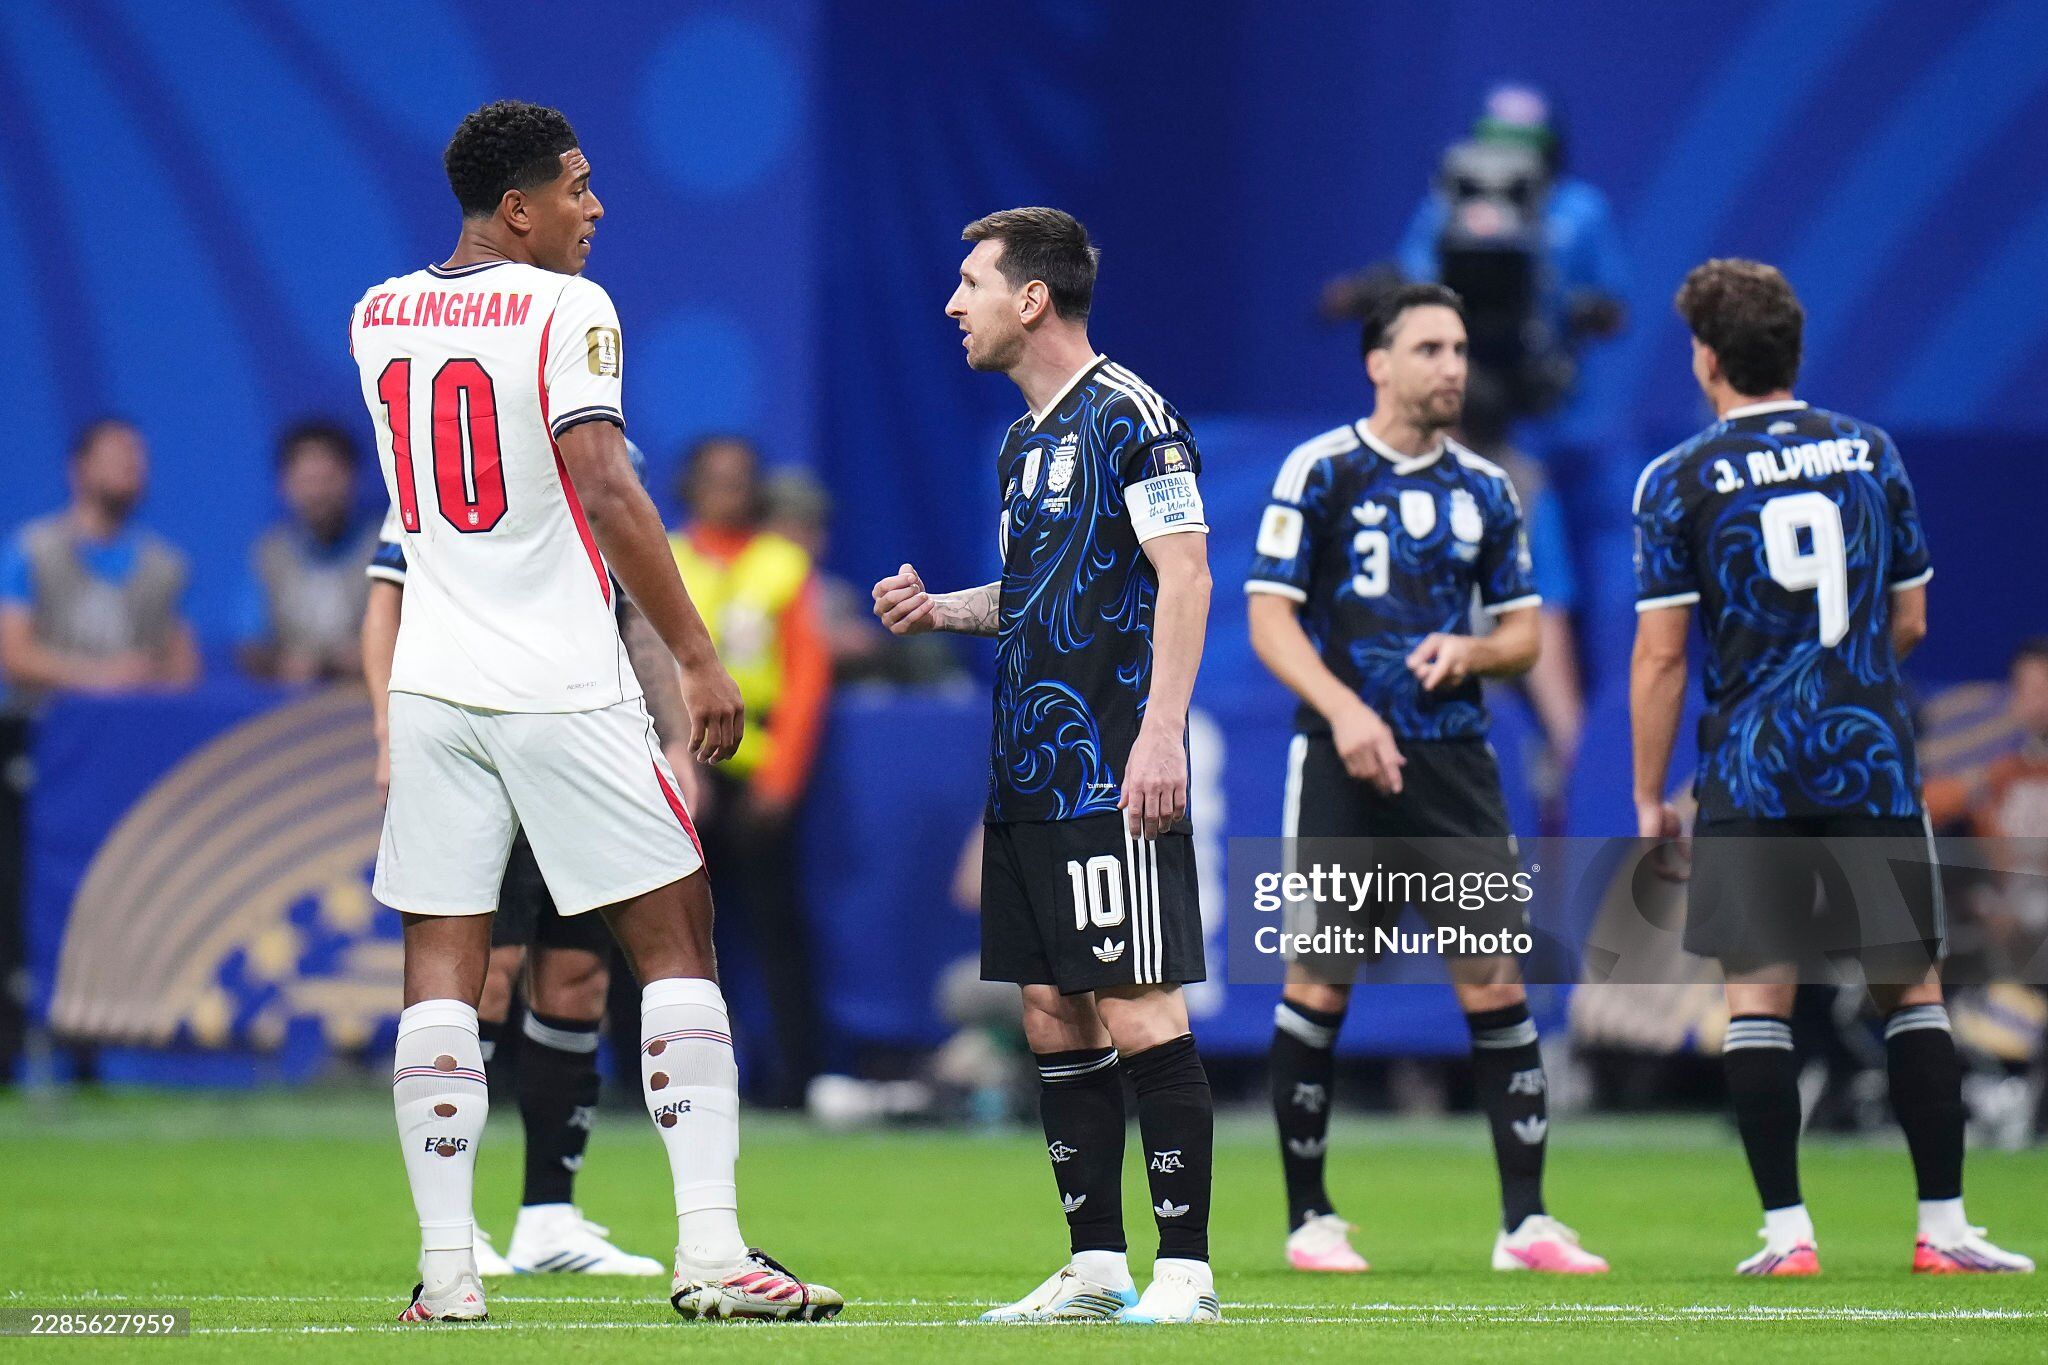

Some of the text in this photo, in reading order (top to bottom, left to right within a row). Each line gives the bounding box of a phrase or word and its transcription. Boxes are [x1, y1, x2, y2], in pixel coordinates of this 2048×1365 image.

[363, 292, 532, 328] BELLINGHAM
[377, 358, 508, 533] 10
[1714, 438, 1874, 493] J. ALVAREZ
[1145, 477, 1188, 493] FOOTBALL
[1148, 486, 1192, 505] UNITES
[1167, 499, 1196, 512] World
[1166, 513, 1184, 522] FIFA
[1352, 530, 1390, 597] 3
[1760, 492, 1849, 647] 9
[1067, 855, 1125, 930] 10
